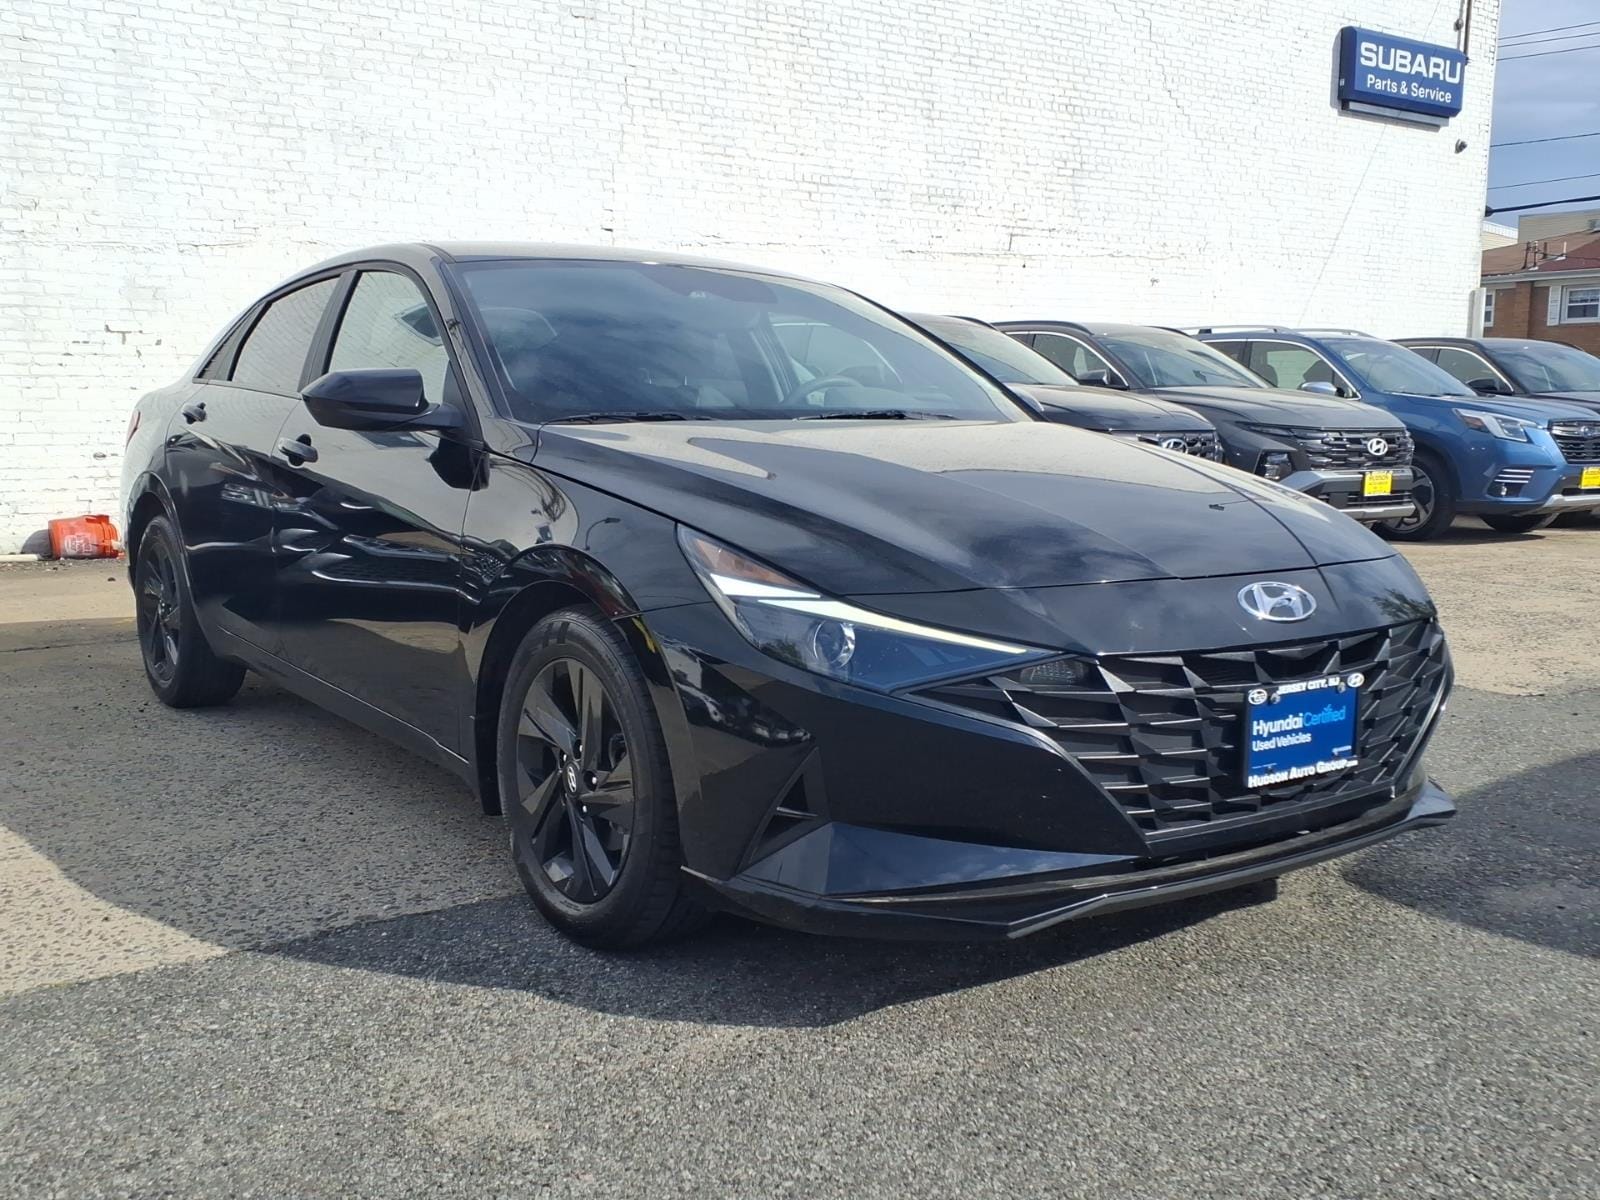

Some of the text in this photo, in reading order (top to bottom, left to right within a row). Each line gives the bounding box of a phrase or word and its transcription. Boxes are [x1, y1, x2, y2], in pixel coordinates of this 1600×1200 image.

[1360, 41, 1461, 84] SUBARU
[1367, 74, 1452, 103] Parts & Service
[1252, 705, 1345, 737] Hyundai Certified
[1252, 732, 1312, 752] Used Vehicles
